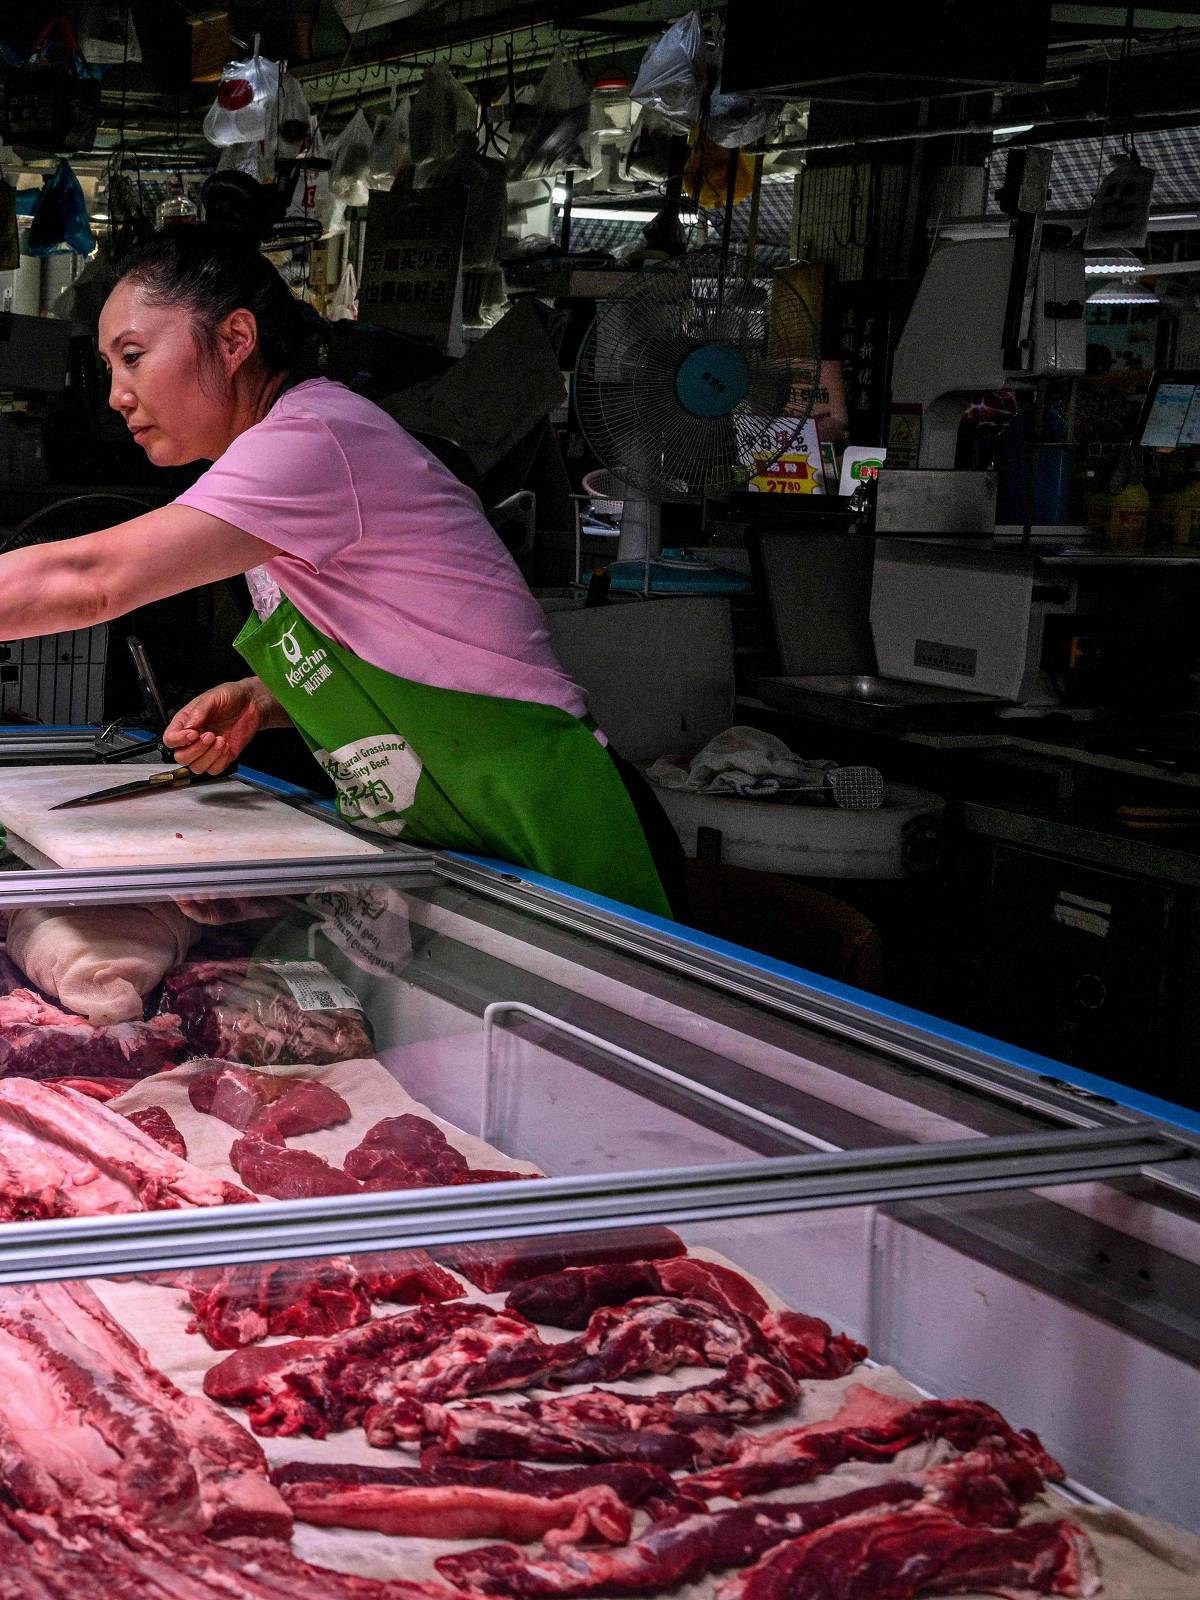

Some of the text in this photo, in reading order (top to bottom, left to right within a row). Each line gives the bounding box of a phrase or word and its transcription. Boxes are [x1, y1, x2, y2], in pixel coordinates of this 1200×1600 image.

[285, 647, 328, 688] Kerchin
[360, 741, 406, 758] Grassland
[369, 756, 391, 771] Beef
